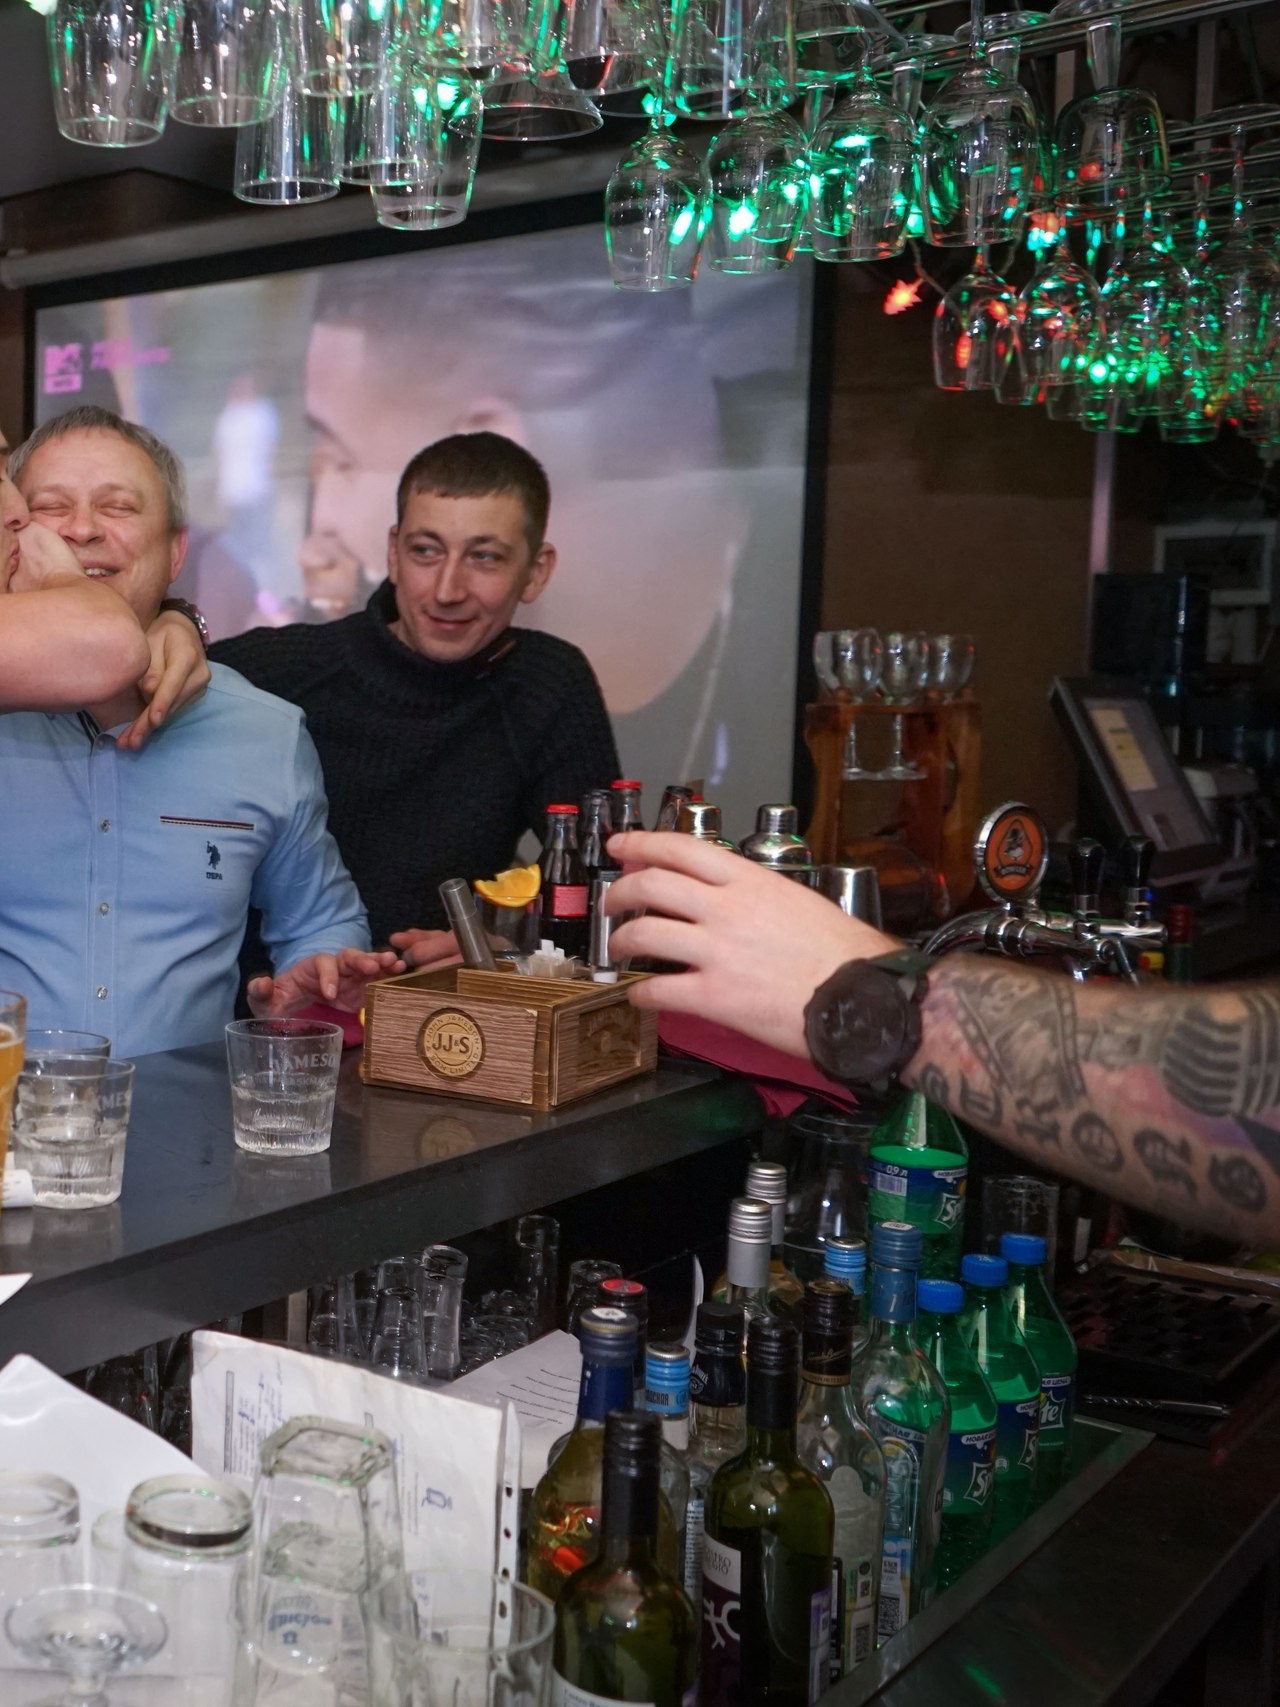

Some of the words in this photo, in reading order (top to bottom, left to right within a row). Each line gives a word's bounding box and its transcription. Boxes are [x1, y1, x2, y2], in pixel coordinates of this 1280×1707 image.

[427, 1019, 443, 1038] JOHN
[447, 1016, 480, 1044] JAMESON
[432, 1033, 470, 1054] JJ&S
[450, 1055, 479, 1074] LIMITED
